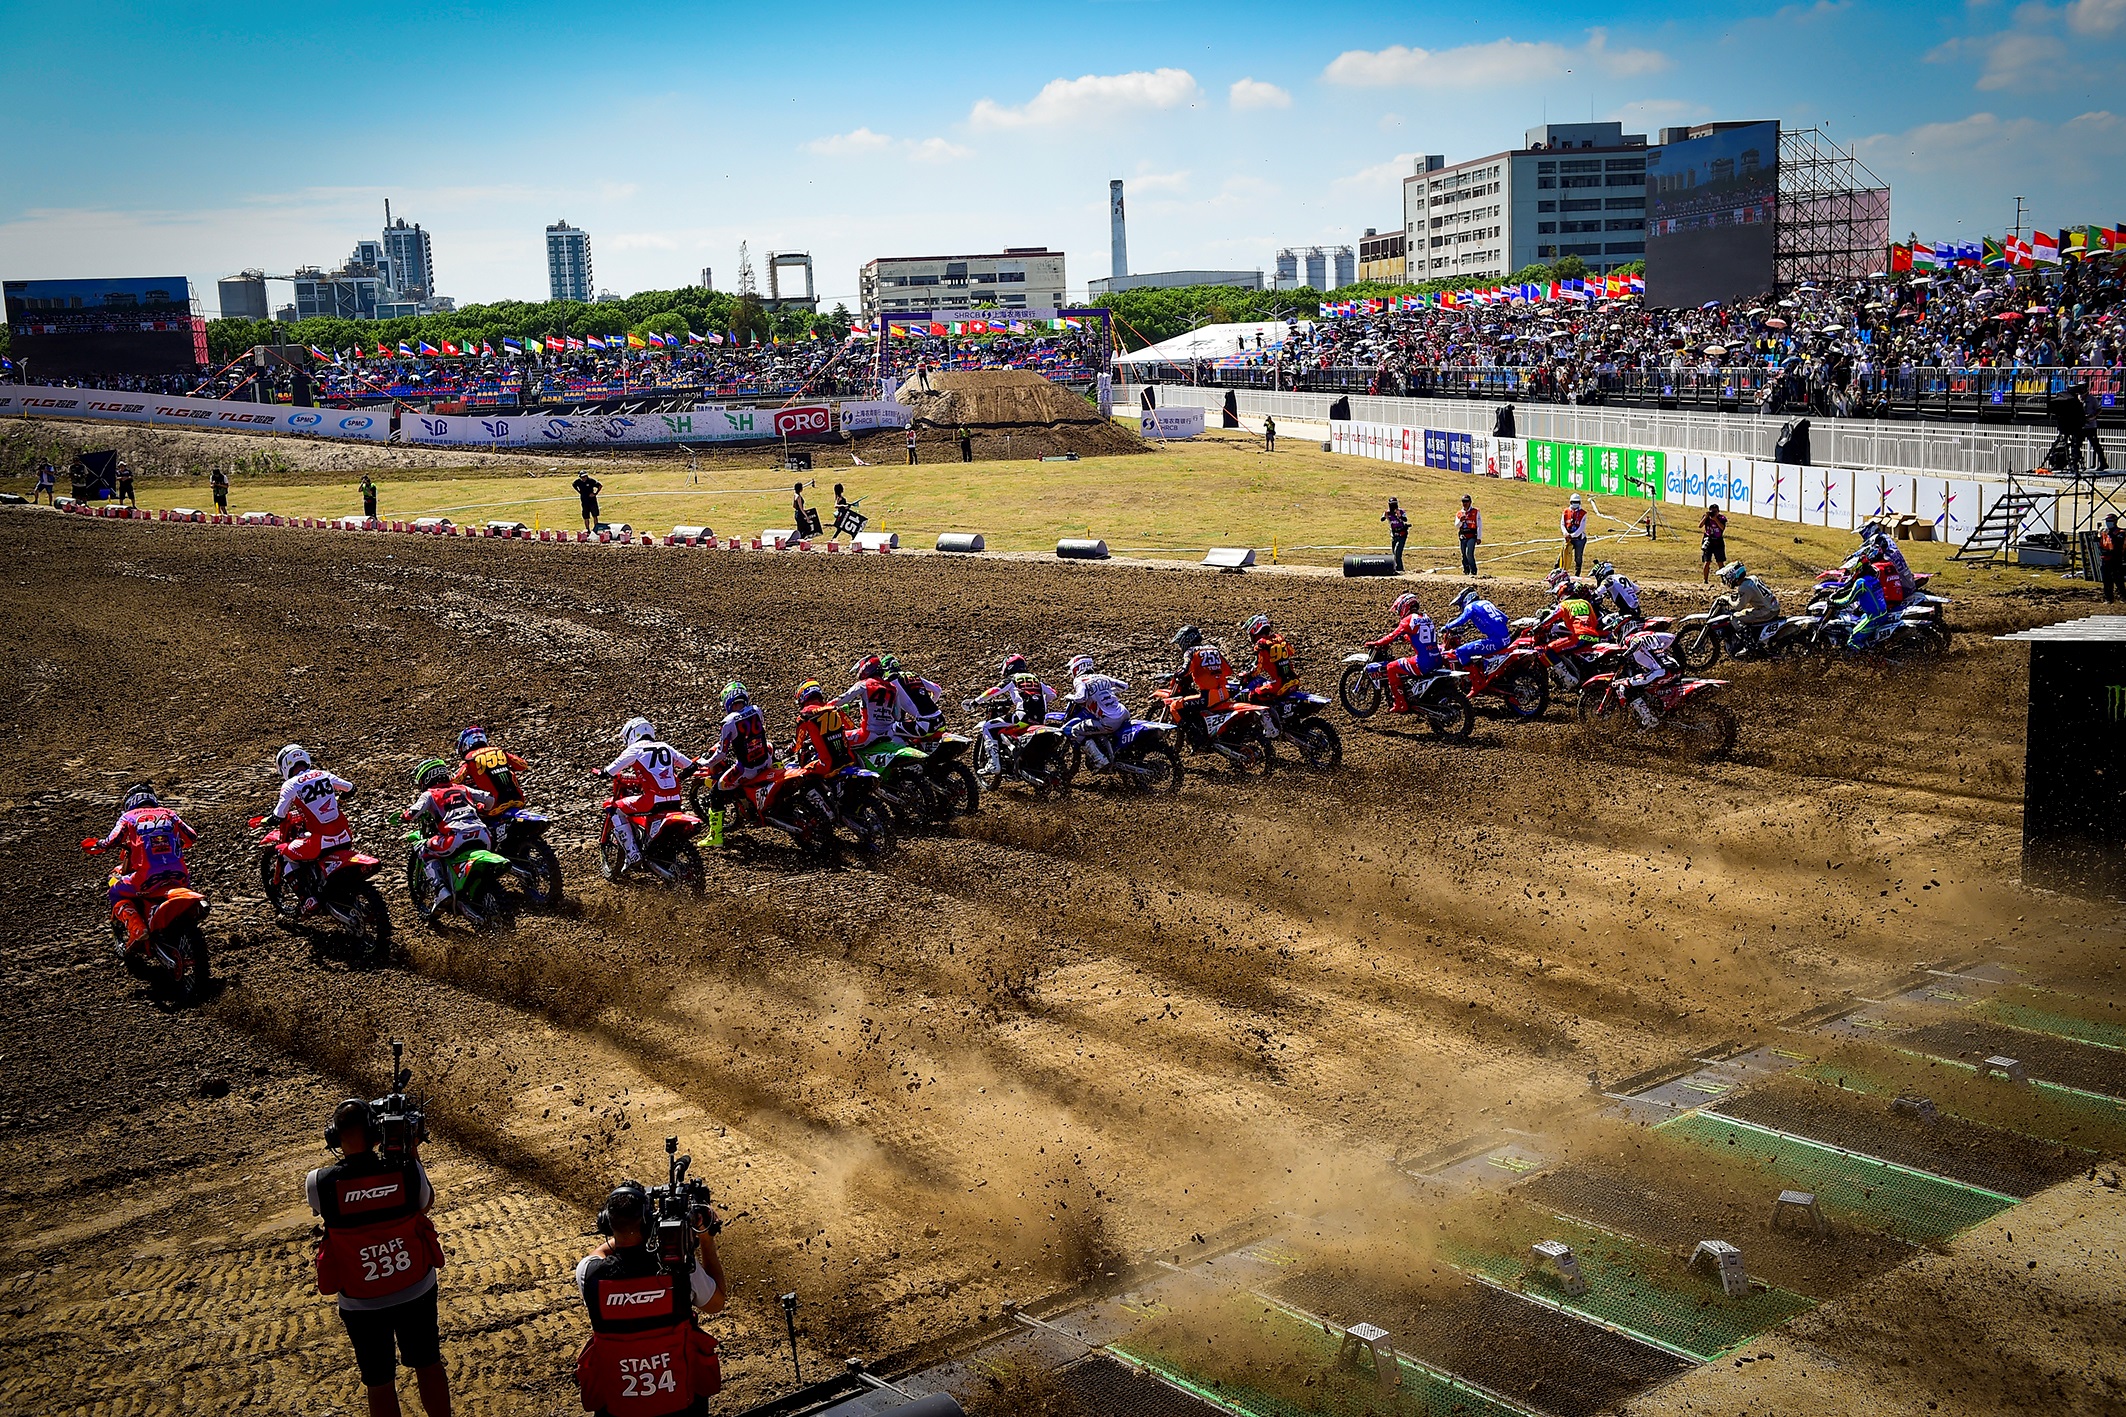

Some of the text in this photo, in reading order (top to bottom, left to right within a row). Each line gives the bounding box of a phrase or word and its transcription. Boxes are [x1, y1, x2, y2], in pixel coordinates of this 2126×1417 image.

[954, 310, 1036, 319] SHRCB 上海农商银行
[778, 411, 827, 433] CRC
[1157, 417, 1192, 425] 上海农商银行
[1667, 471, 1705, 497] Gaten
[844, 514, 860, 533] 15
[1419, 624, 1437, 644] 87
[1200, 649, 1222, 667] 253
[1269, 641, 1289, 663] 93
[1473, 643, 1497, 652] FXR
[868, 687, 897, 712] 41
[817, 711, 843, 735] 10
[642, 746, 672, 769] 70
[874, 753, 887, 768] 41
[301, 777, 334, 805] 243
[136, 814, 174, 836] 84
[344, 1183, 399, 1203] MXGP
[359, 1237, 405, 1262] STAFF
[361, 1249, 411, 1282] 238
[606, 1289, 666, 1307] MXGP
[619, 1352, 671, 1374] STAFF
[621, 1369, 676, 1398] 234
